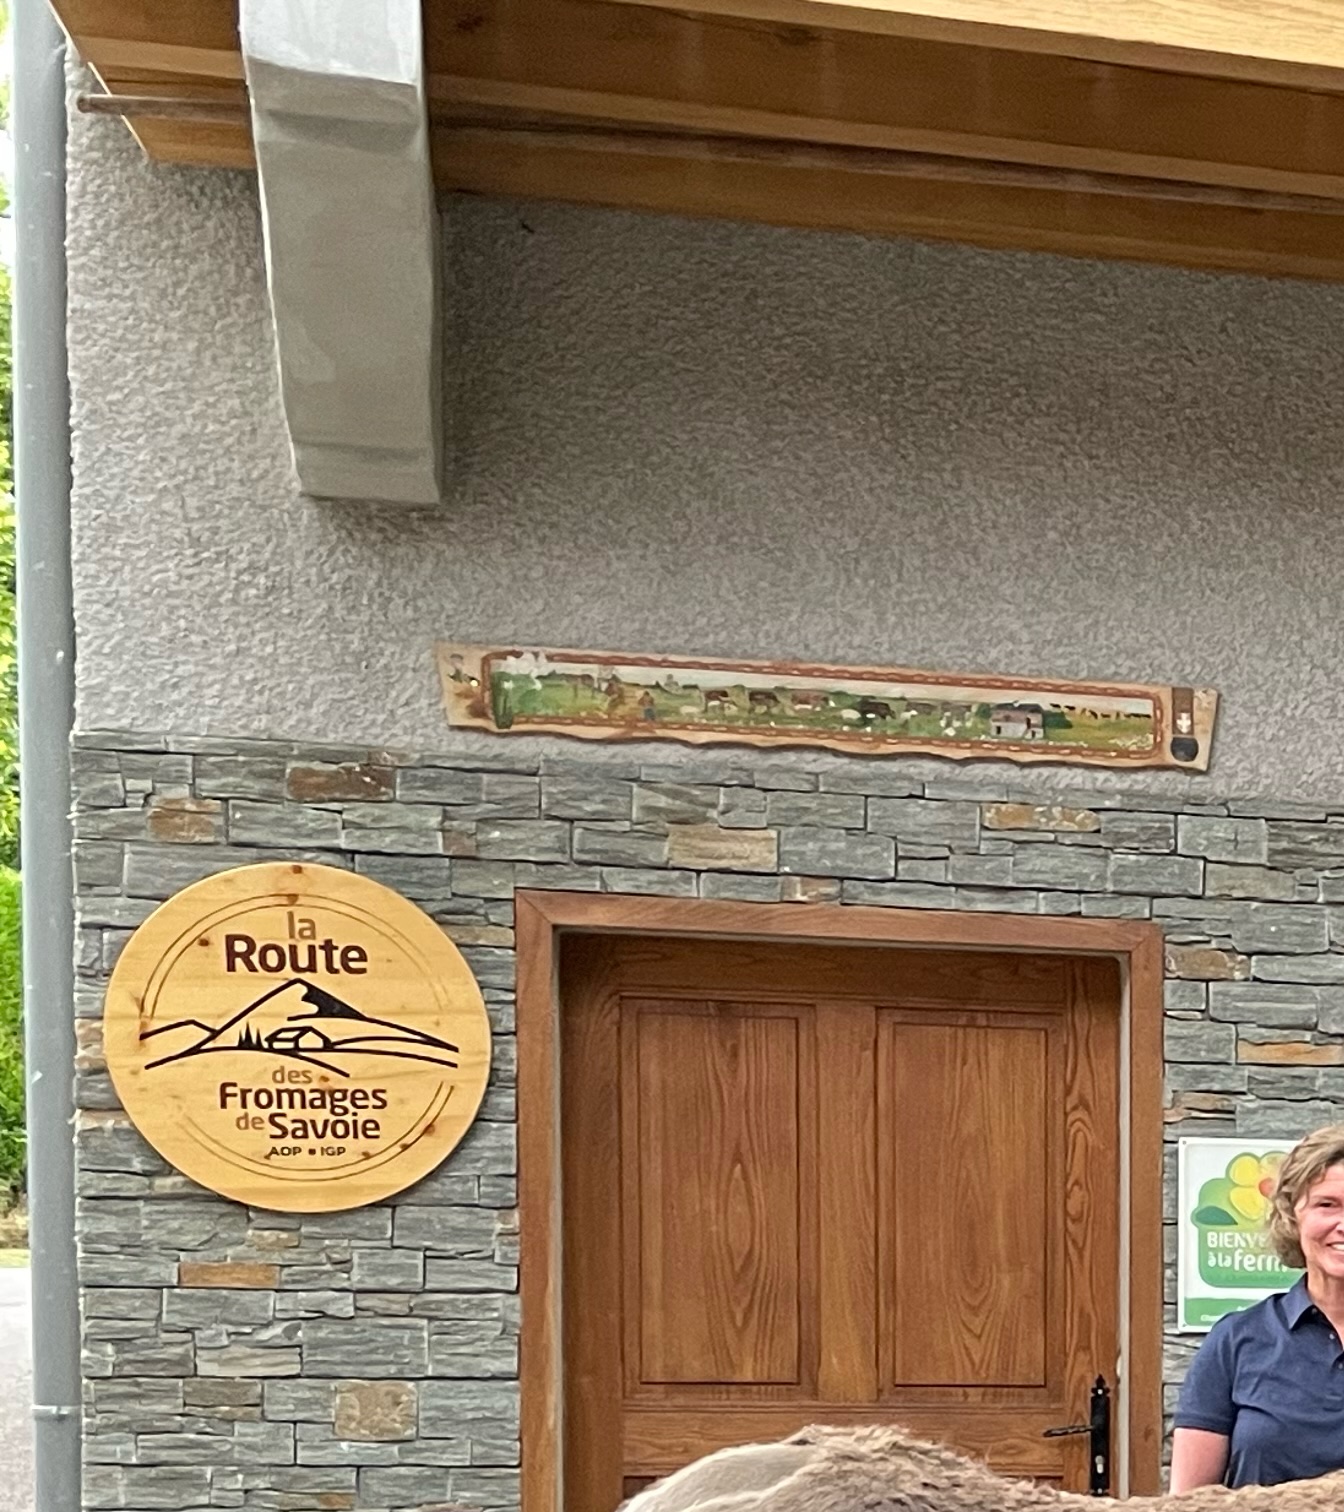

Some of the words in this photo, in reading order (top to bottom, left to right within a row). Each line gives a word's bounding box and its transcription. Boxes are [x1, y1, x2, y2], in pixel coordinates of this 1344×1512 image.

[287, 911, 316, 940] la
[225, 934, 368, 974] Route
[272, 1065, 313, 1084] des
[219, 1082, 388, 1116] Fromages
[235, 1112, 265, 1130] de
[268, 1112, 380, 1139] Savoie
[269, 1146, 302, 1156] AOP
[321, 1147, 346, 1156] IGP
[1207, 1231, 1269, 1248] BIENVE
[1207, 1251, 1217, 1267] à
[1218, 1251, 1232, 1267] la
[1234, 1248, 1289, 1273] ferm
